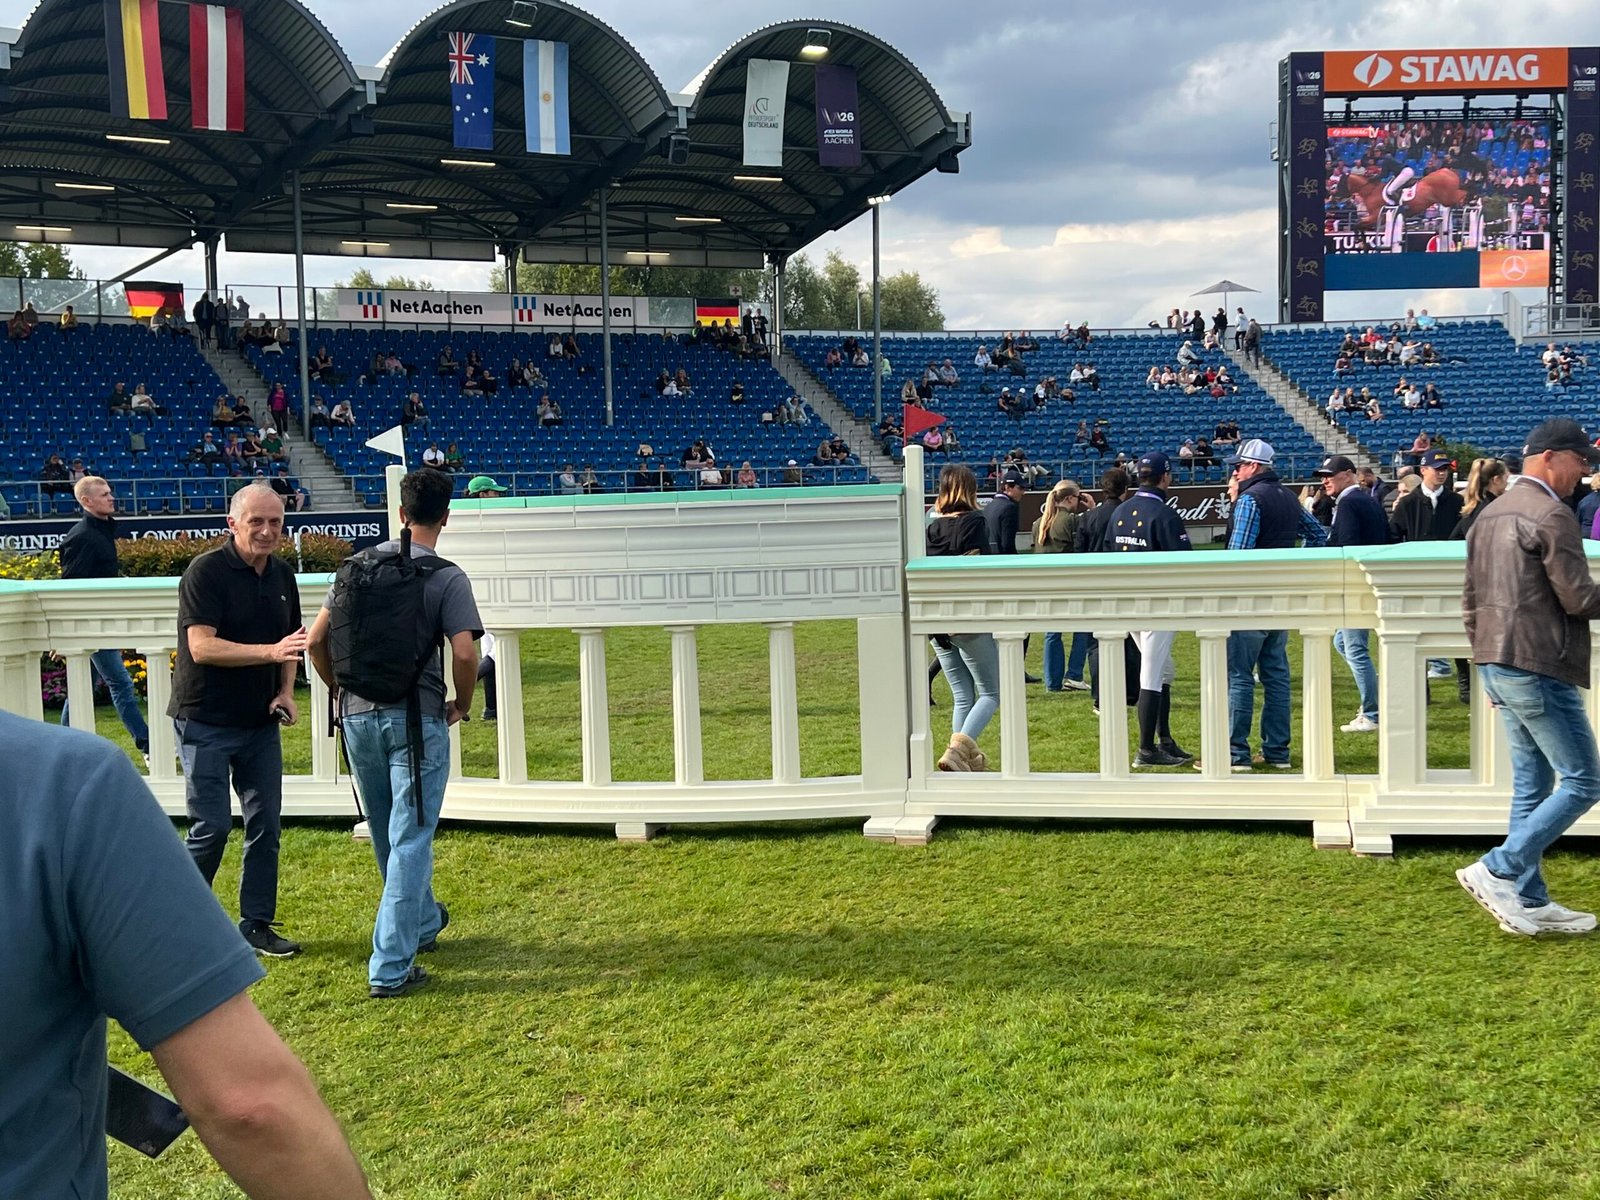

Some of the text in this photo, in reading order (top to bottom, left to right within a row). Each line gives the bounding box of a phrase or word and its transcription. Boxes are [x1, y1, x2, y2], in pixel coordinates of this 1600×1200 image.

[1400, 54, 1539, 83] STAWAG
[390, 299, 483, 315] NetAachen
[286, 523, 380, 539] LONGINES
